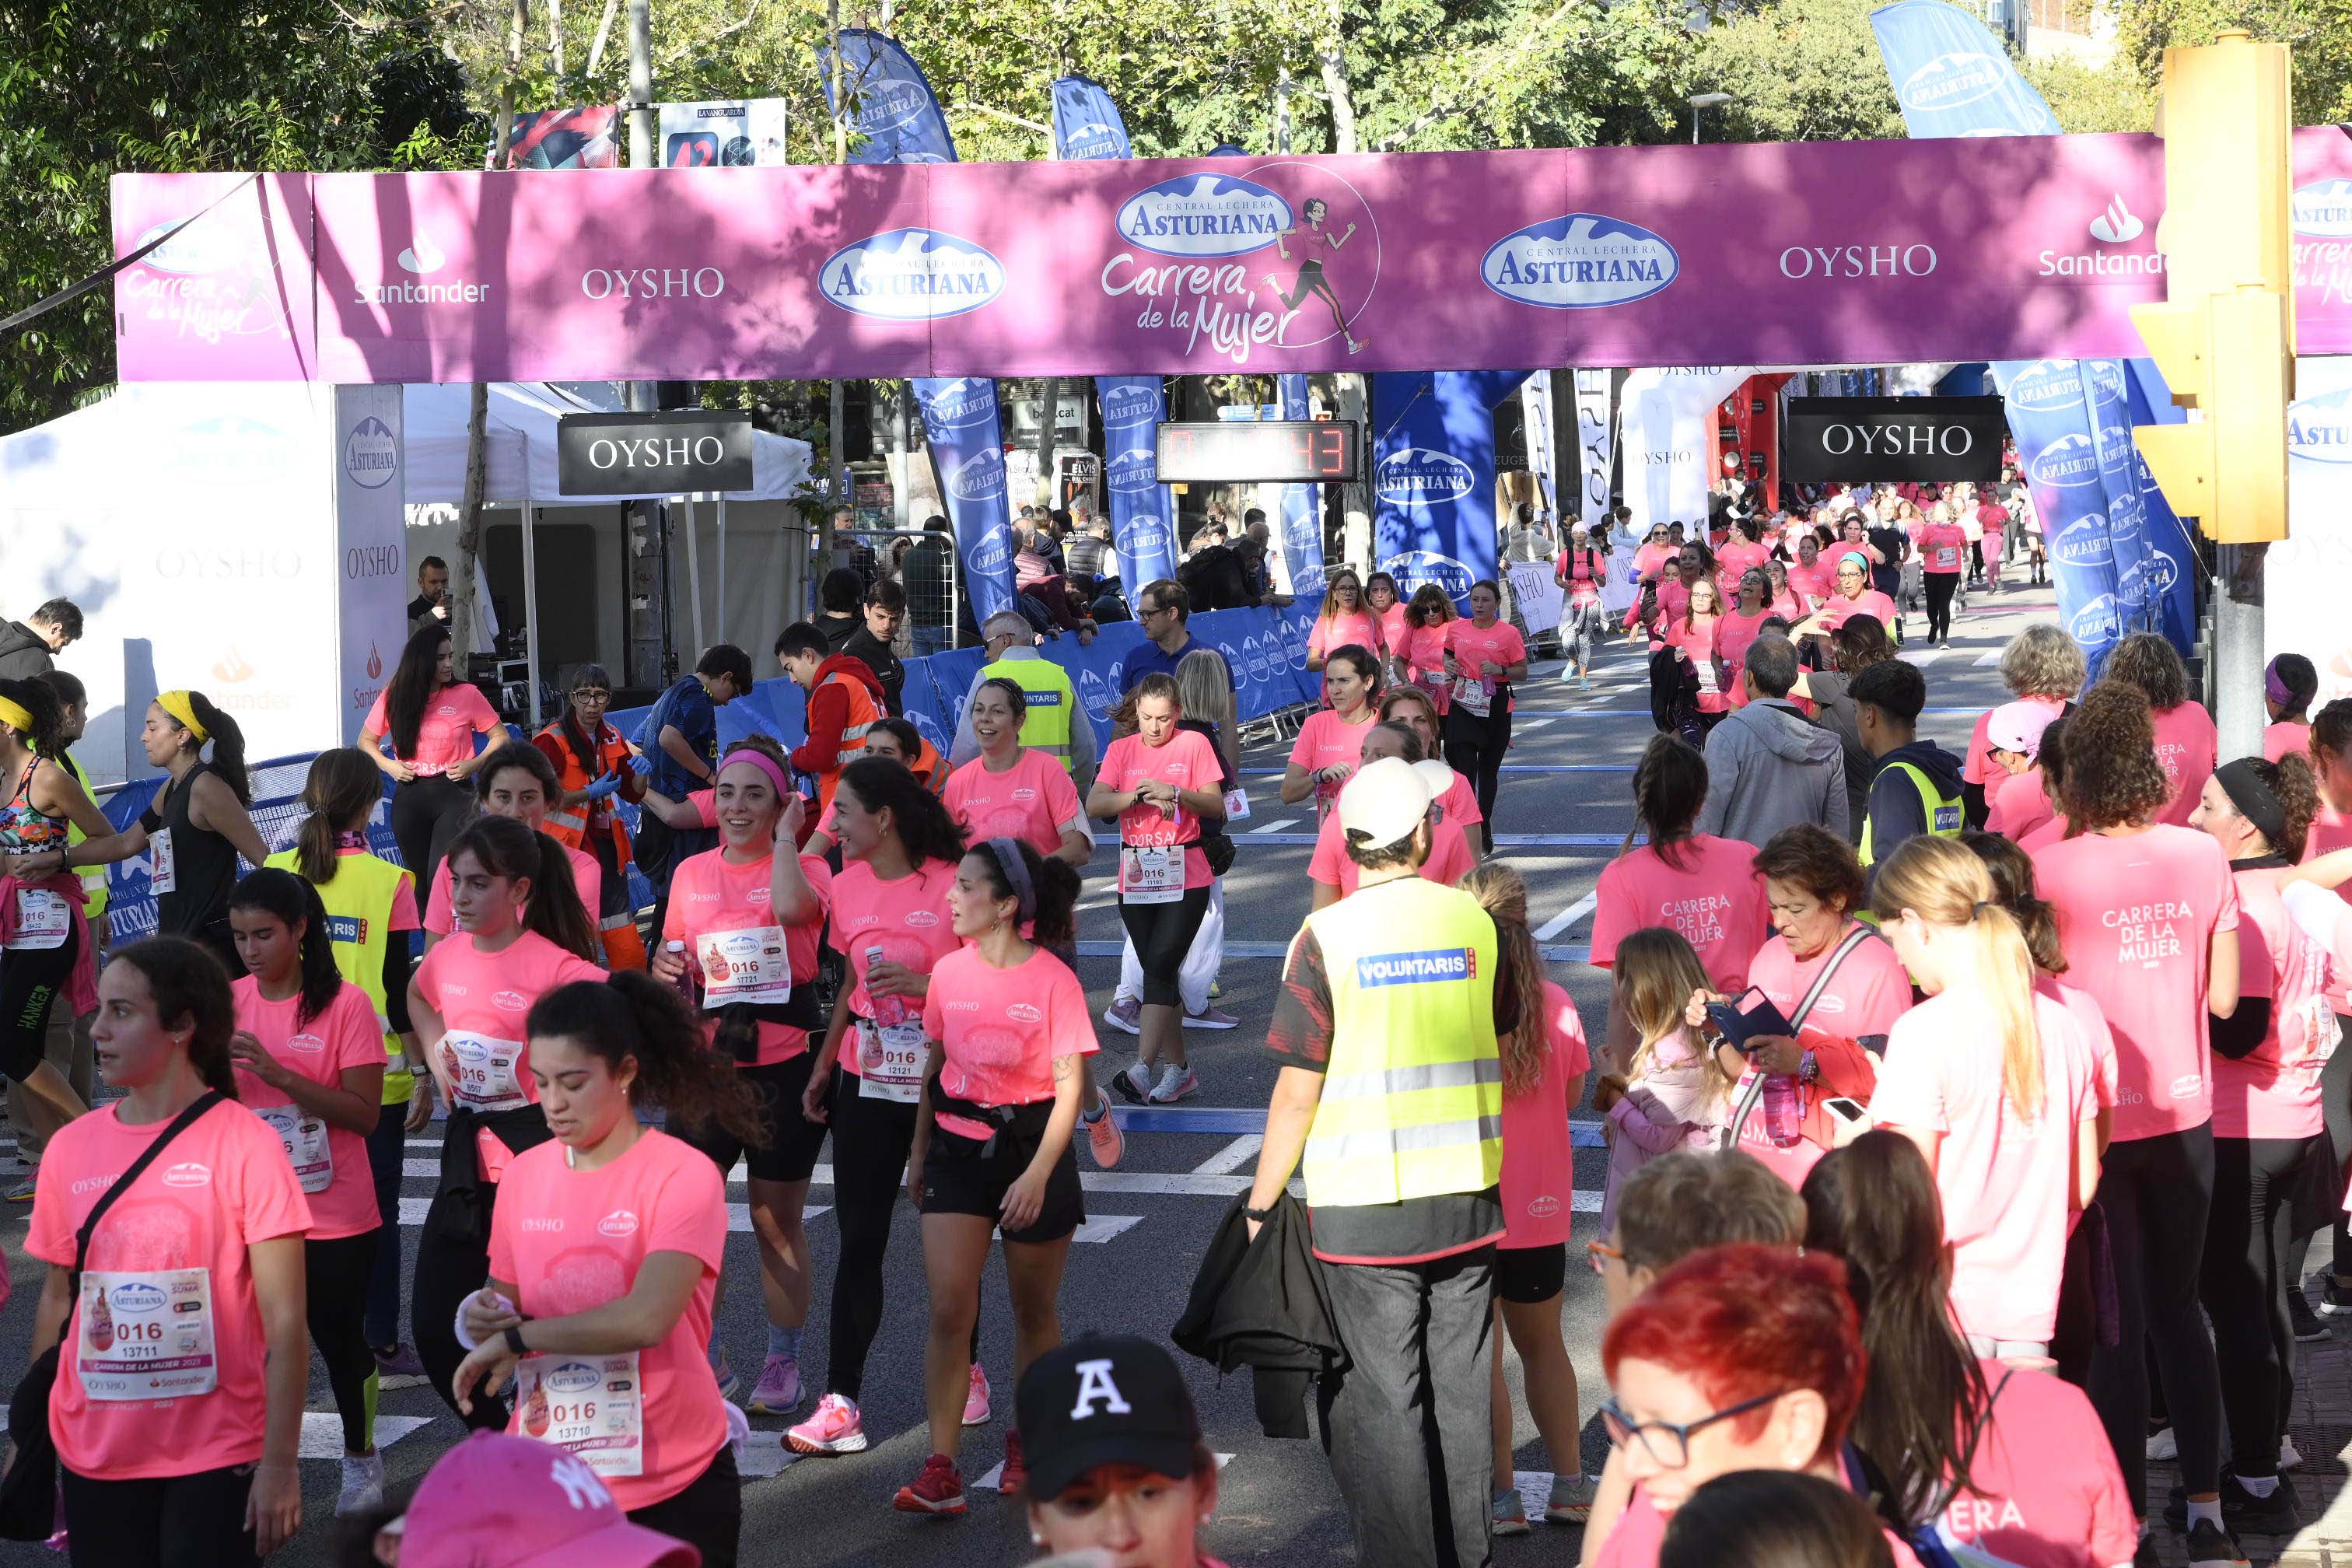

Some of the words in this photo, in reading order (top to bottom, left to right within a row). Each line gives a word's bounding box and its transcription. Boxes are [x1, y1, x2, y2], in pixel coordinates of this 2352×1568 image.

[1157, 201, 1213, 212] CENTRAL
[1218, 200, 1275, 211] LECHERA
[1129, 205, 1280, 237] ASTURIANA
[1526, 247, 1589, 257] CENTRAL
[1594, 245, 1657, 255] LECHERA
[1496, 250, 1664, 285] ASTURIANA
[1780, 243, 1937, 279] OYSHO
[582, 266, 725, 301] OYSHO
[833, 263, 991, 297] ASTURIANA
[1101, 253, 1246, 296] Carrera
[354, 280, 490, 305] Santander
[1137, 299, 1164, 329] de
[1170, 296, 1190, 329] la
[1185, 290, 1300, 364] Mujer
[1822, 423, 1974, 457] OYSHO
[349, 443, 394, 471] ASTURIANA
[589, 436, 723, 469] OYSHO
[1071, 464, 1096, 474] ELVIS
[1378, 472, 1467, 492] ASTURIANA
[347, 544, 399, 579] OYSHO
[1424, 569, 1464, 577] LECHERA
[1144, 869, 1164, 878] 016
[1661, 894, 1731, 917] CARRERA
[26, 911, 45, 922] 016
[1676, 915, 1696, 930] DE
[1699, 912, 1720, 927] LA
[2102, 901, 2193, 929] CARRERA
[2121, 926, 2145, 944] DE
[2152, 922, 2176, 940] LA
[725, 943, 758, 952] ASTURIANA
[2118, 938, 2182, 964] MUJER
[731, 960, 760, 974] 016
[1360, 956, 1465, 981] VOLUNTARIS
[737, 975, 758, 985] 17721
[946, 1001, 980, 1011] OYSHO
[885, 1051, 916, 1064] 016
[461, 1067, 486, 1083] 016
[887, 1066, 912, 1076] 12121
[114, 1293, 164, 1306] ASTURIANA
[117, 1322, 163, 1341] 016
[122, 1346, 158, 1359] 13711
[138, 1362, 149, 1370] LA
[160, 1375, 206, 1388] Santander
[551, 1374, 597, 1387] ASTURIANA
[1070, 1358, 1132, 1422] A
[553, 1402, 597, 1423] 016
[558, 1425, 591, 1439] 13710
[588, 1455, 631, 1468] Santander
